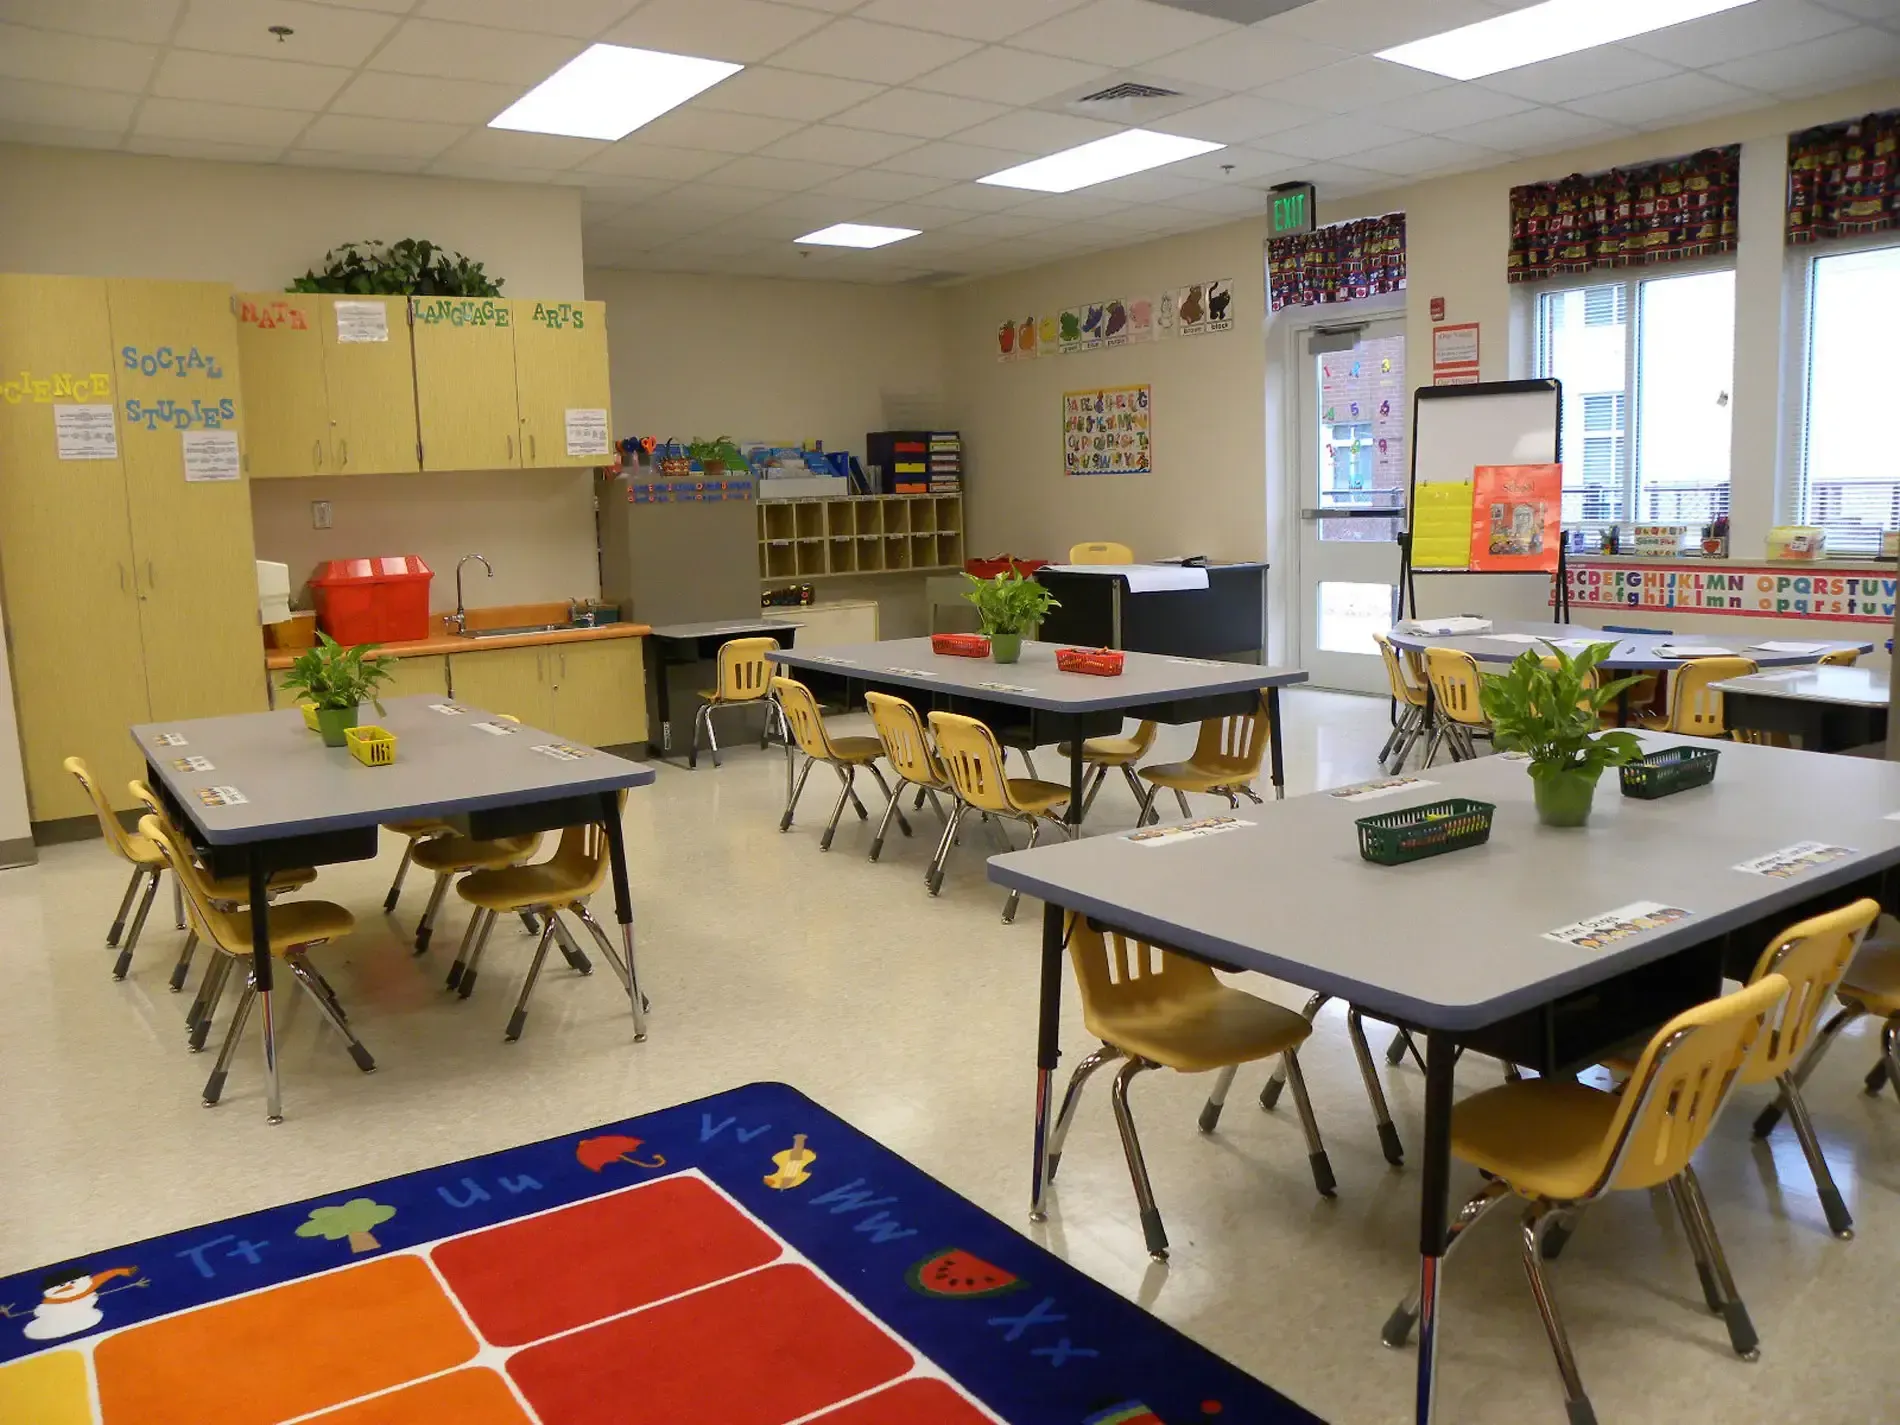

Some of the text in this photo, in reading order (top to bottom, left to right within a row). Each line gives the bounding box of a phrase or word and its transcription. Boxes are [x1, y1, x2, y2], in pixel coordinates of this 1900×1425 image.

[1273, 193, 1305, 232] EXIT
[413, 299, 509, 327] LANGUAGE
[532, 303, 584, 329] ARTS
[122, 346, 223, 378] SOCIAL
[0, 371, 110, 404] CIENCE
[126, 398, 234, 430] STUDIES
